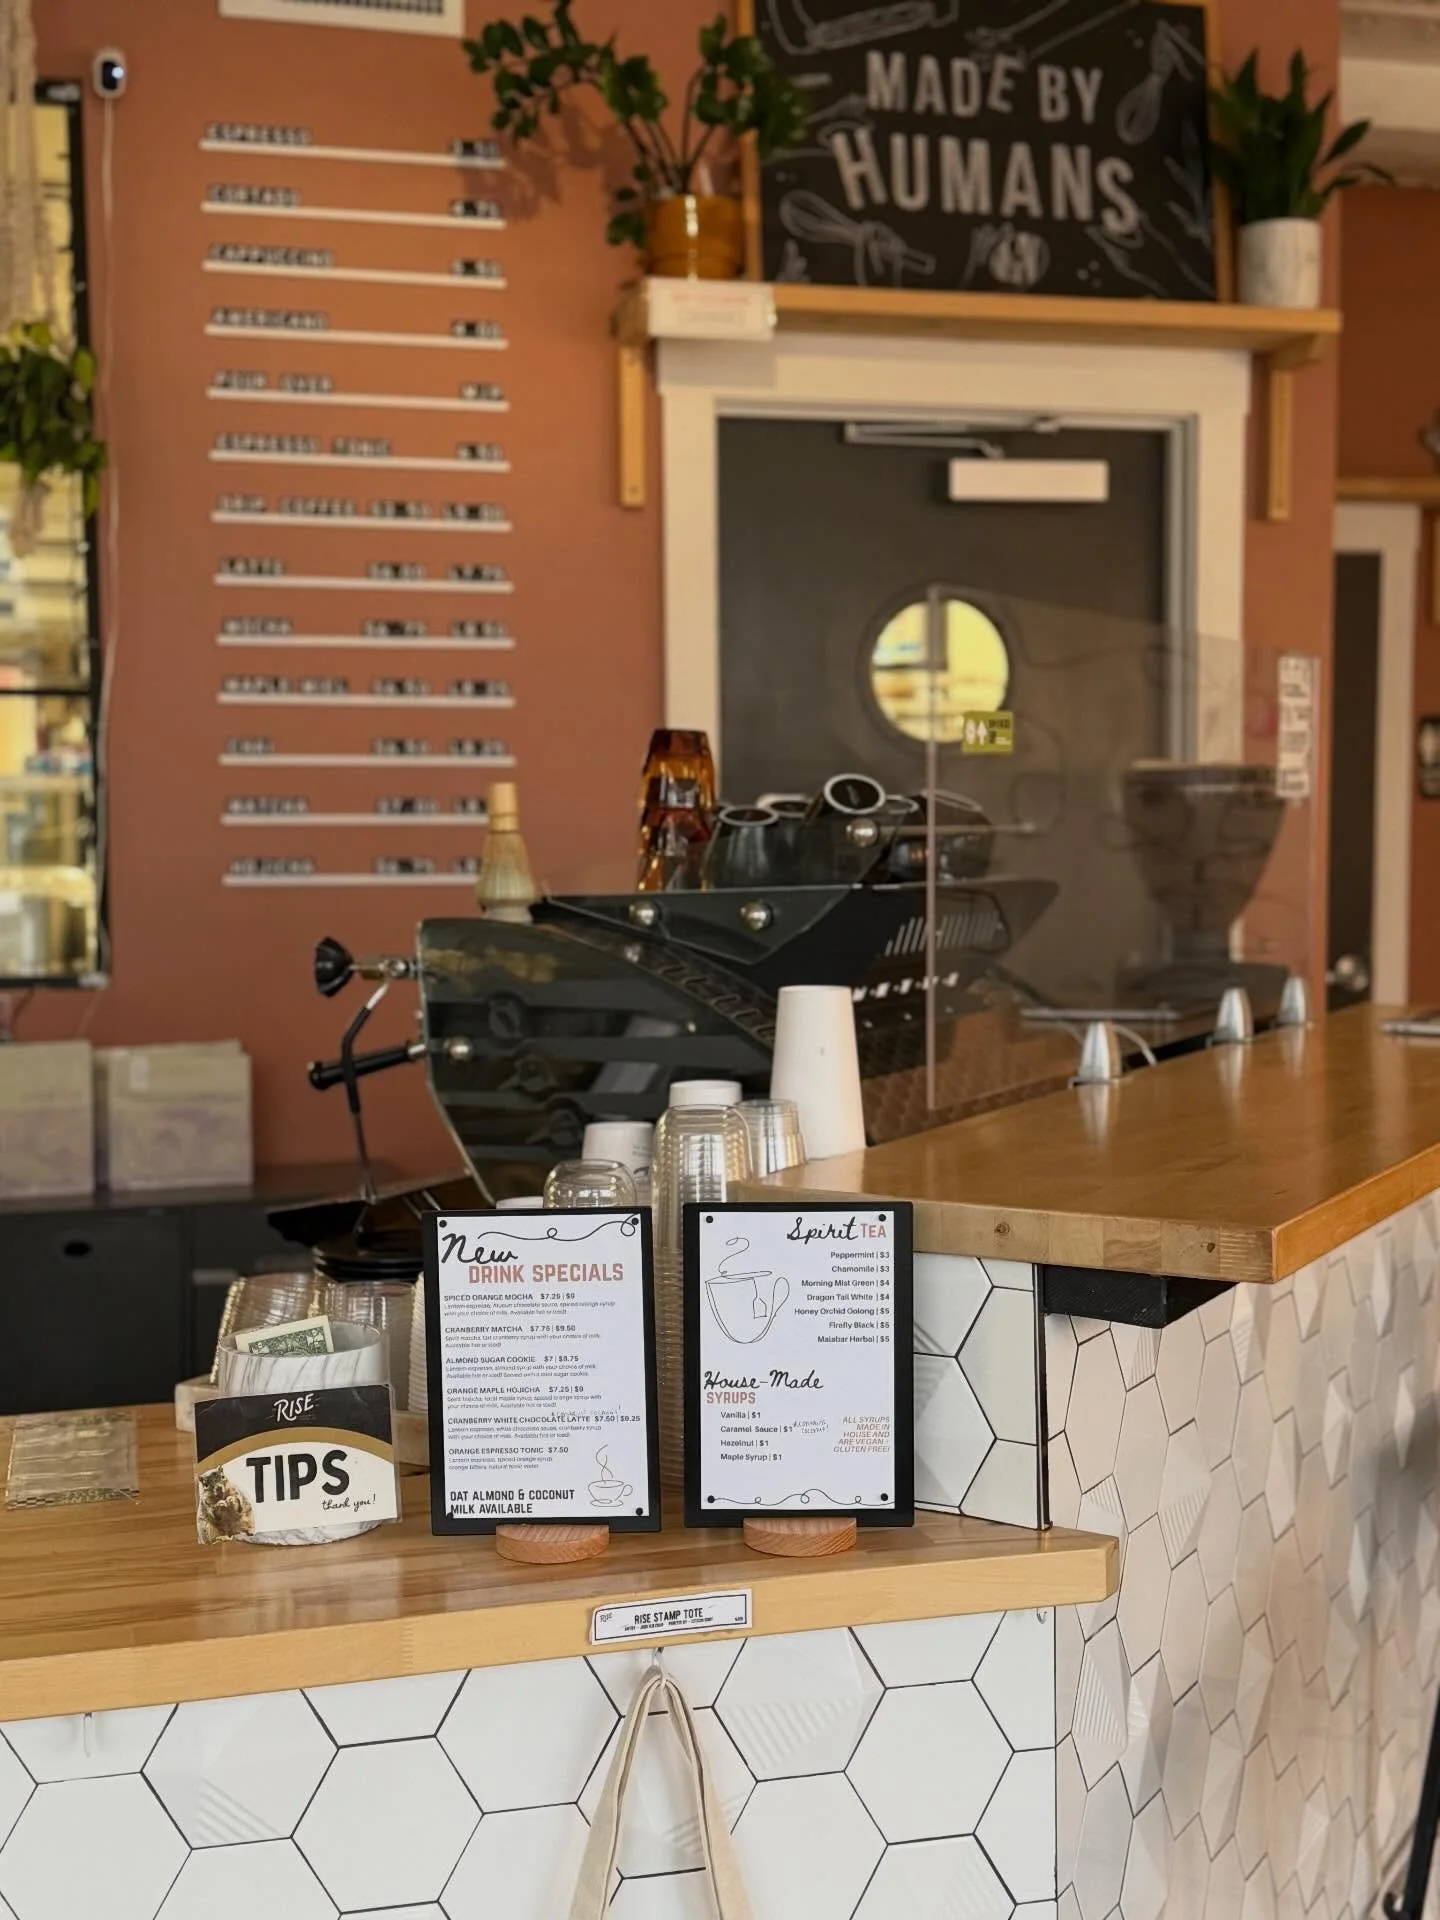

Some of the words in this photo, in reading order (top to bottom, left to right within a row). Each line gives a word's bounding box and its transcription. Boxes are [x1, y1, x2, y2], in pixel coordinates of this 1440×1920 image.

[867, 51, 1024, 117] MADE
[1038, 64, 1102, 125] BY
[831, 128, 1140, 236] HUMANS
[787, 1217, 858, 1244] Spirit
[860, 1223, 886, 1238] TEA
[441, 1233, 518, 1264] New
[831, 1251, 874, 1260] Peppermint
[880, 1251, 889, 1259] $3
[468, 1264, 524, 1284] DRINK
[532, 1263, 624, 1282] SPECIALS
[831, 1265, 874, 1273] Chamomile
[880, 1265, 889, 1273] $3
[801, 1280, 833, 1288] Morning
[505, 1293, 533, 1301] MOCHA
[807, 1294, 835, 1302] Dragon
[836, 1293, 850, 1301] Tail
[851, 1293, 873, 1301] White
[880, 1293, 889, 1301] $4
[795, 1307, 819, 1316] Honey
[820, 1307, 845, 1315] Orchid
[847, 1307, 874, 1316] Oolong
[880, 1307, 889, 1315] $5
[445, 1326, 490, 1334] CRANBERRY
[829, 1321, 852, 1330] Firefly
[849, 1335, 874, 1343] Herbal
[880, 1335, 889, 1343] $5
[704, 1369, 824, 1391] House-Made
[707, 1392, 756, 1405] SYRUPS
[273, 1393, 315, 1423] RISE
[448, 1417, 493, 1425] CRANBERRY
[519, 1416, 566, 1424] CHOCOLATE
[720, 1425, 752, 1433] Caramel
[755, 1425, 778, 1433] Sauce
[720, 1439, 754, 1447] Hazelnut
[760, 1439, 769, 1447] $1
[721, 1453, 744, 1462] Maple
[745, 1453, 768, 1462] Syrup
[773, 1453, 782, 1461] $1
[246, 1450, 350, 1503] TIPS
[450, 1491, 468, 1502] OAT
[472, 1490, 514, 1501] ALMOND
[518, 1489, 524, 1500] &
[529, 1489, 575, 1500] COCONUT
[321, 1497, 349, 1511] thank
[354, 1494, 376, 1512] you!
[451, 1504, 474, 1515] MILK
[479, 1503, 533, 1514] AVAILABLE
[634, 1613, 651, 1625] RISE
[654, 1610, 680, 1623] STAMP
[684, 1608, 703, 1619] TOTE
